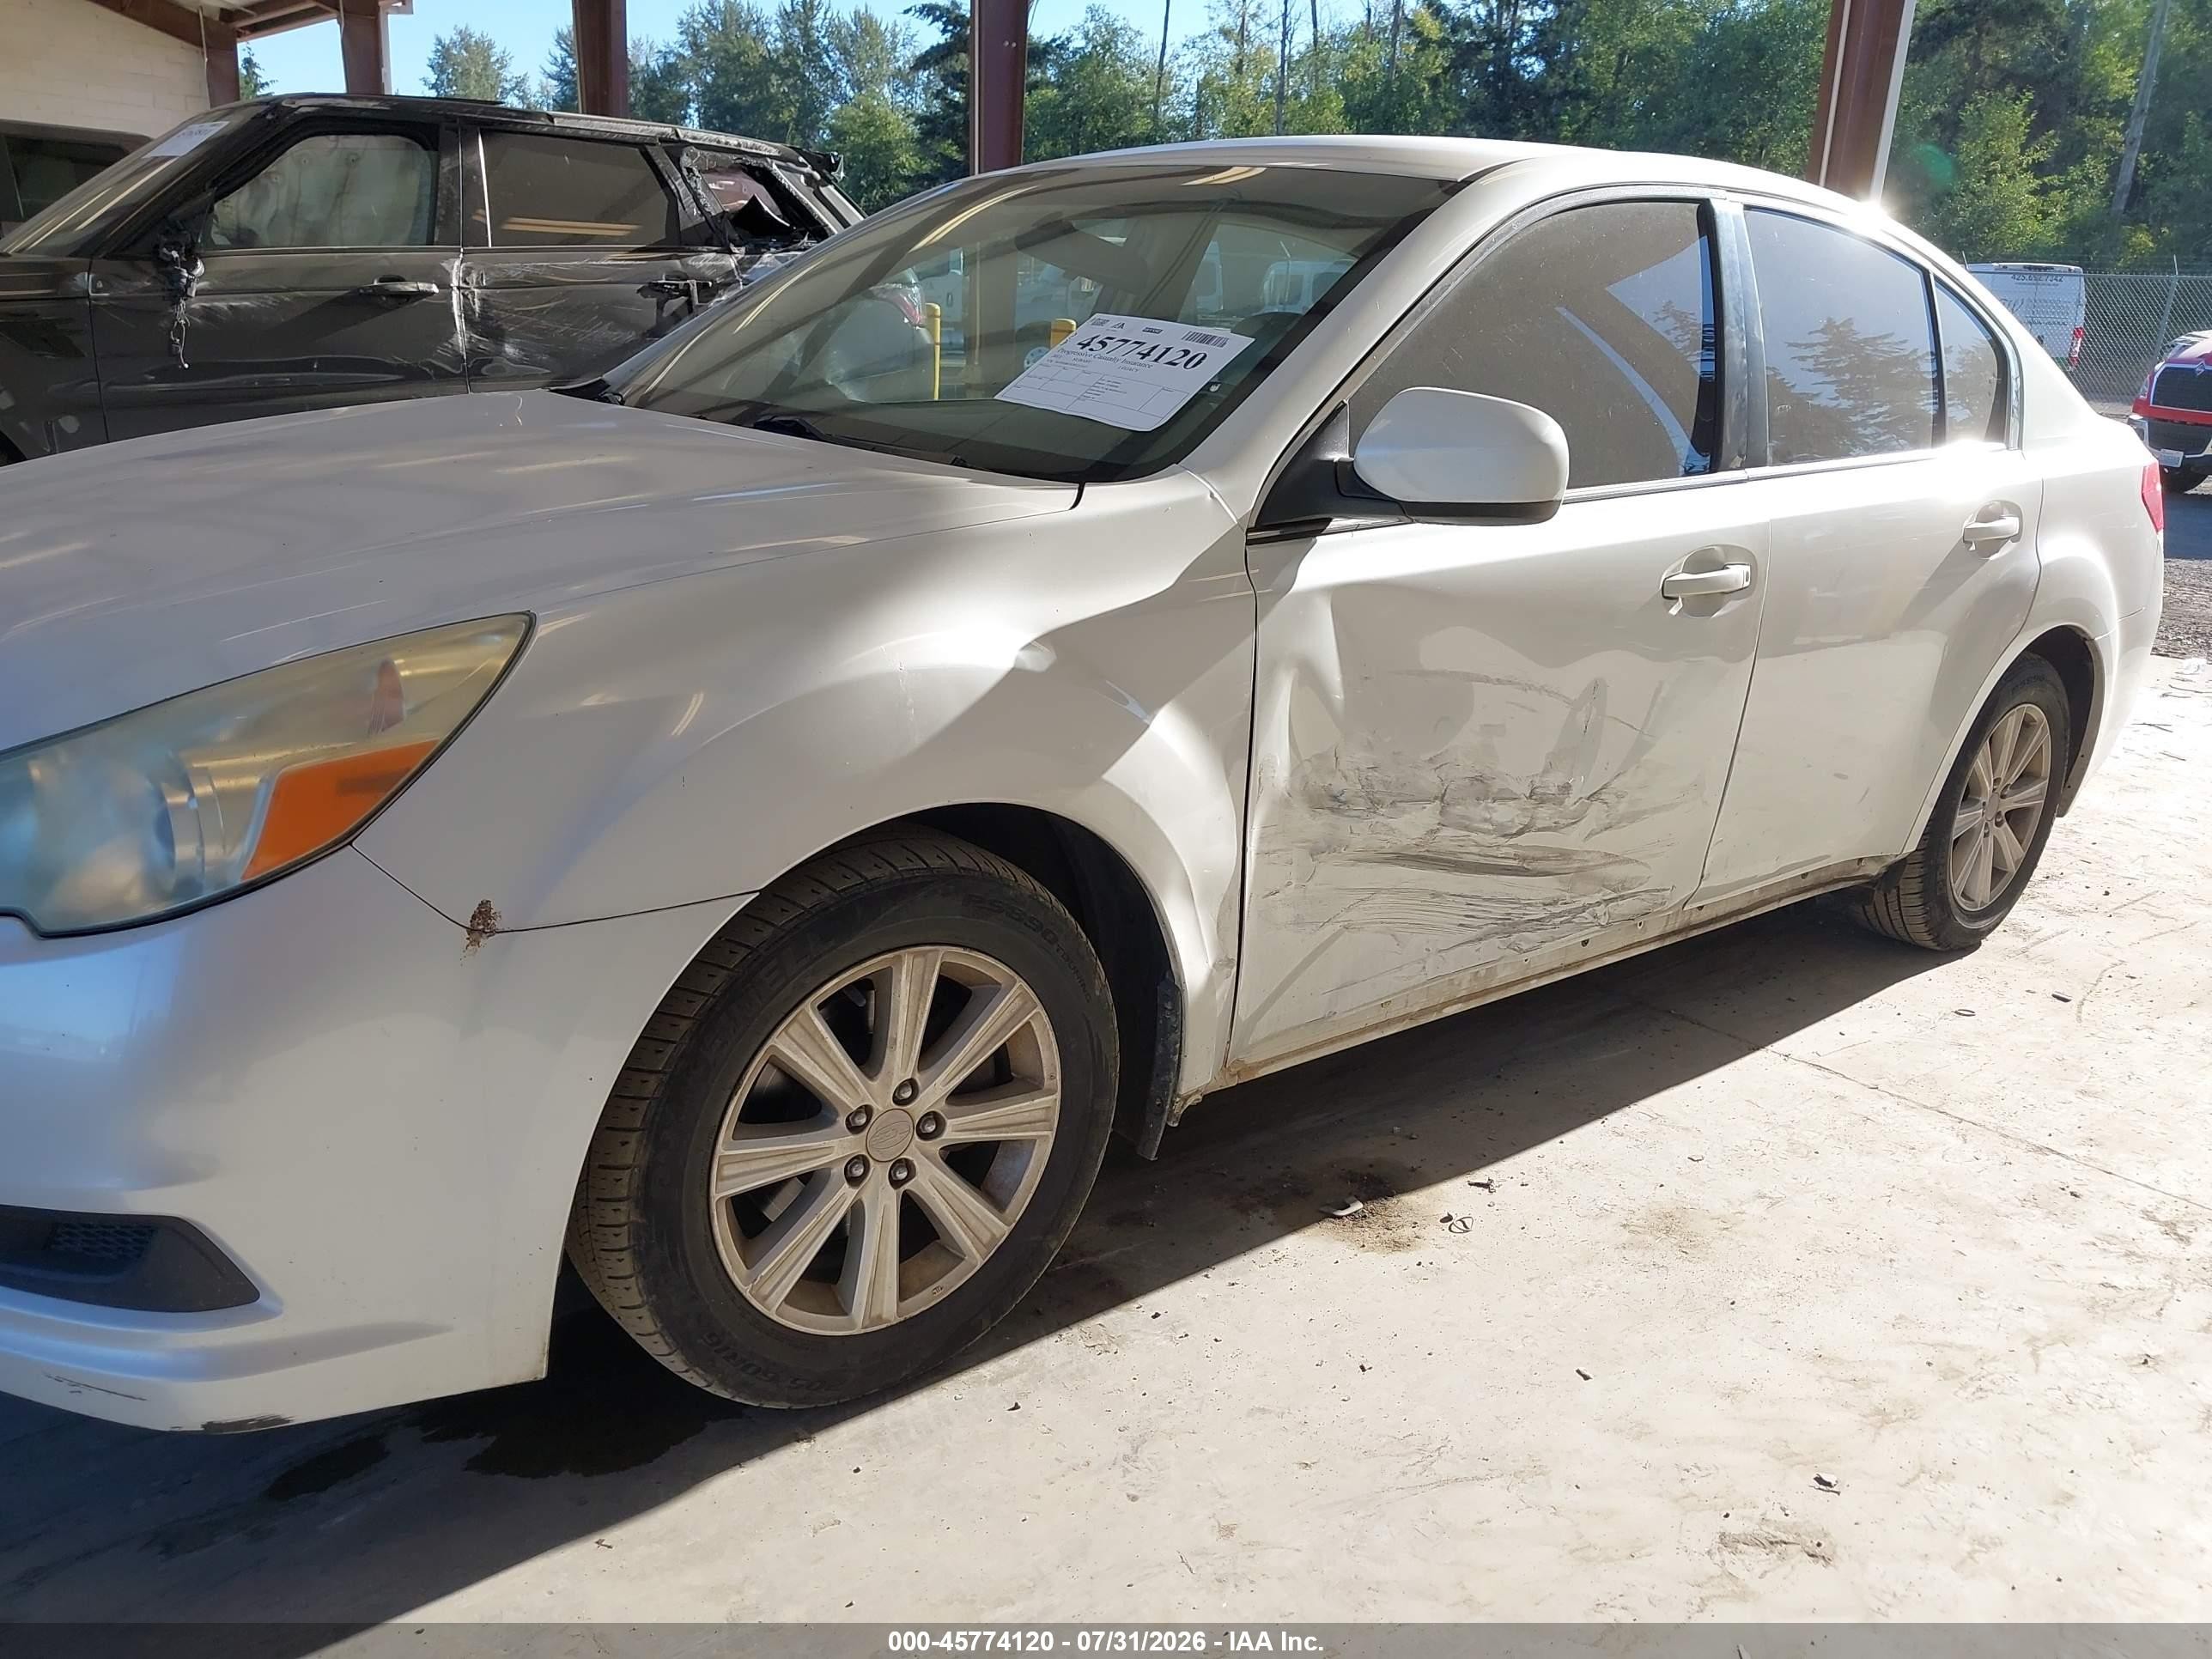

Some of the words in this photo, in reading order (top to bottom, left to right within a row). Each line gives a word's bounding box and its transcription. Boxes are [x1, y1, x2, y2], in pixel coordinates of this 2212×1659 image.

[1057, 348, 1094, 358] Progressive
[1093, 352, 1121, 364] Casualty
[1121, 357, 1153, 369] Insurance
[1077, 334, 1207, 370] 45774120
